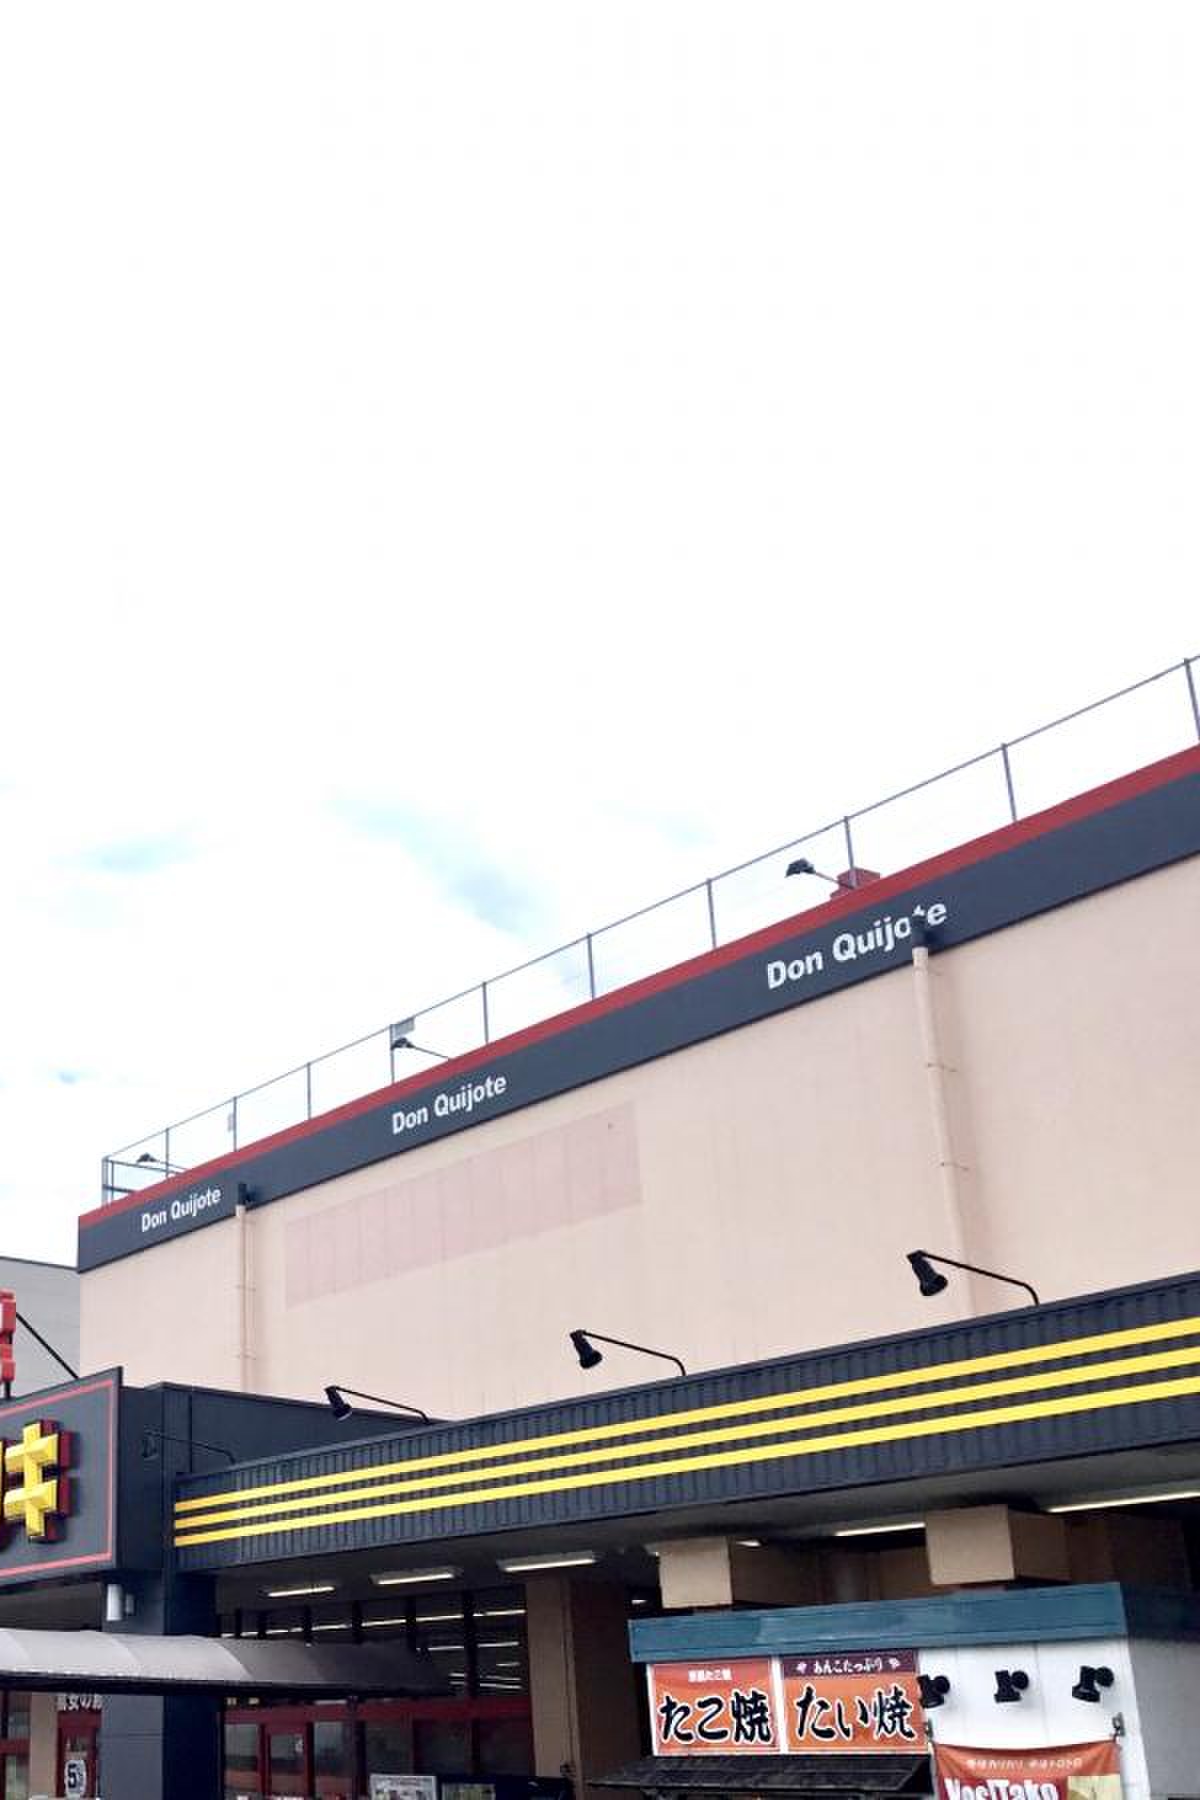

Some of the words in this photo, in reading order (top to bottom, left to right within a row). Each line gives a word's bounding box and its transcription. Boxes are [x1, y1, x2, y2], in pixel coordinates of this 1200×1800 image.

[767, 951, 823, 989] Don
[392, 1106, 428, 1134] Don
[434, 1076, 507, 1117] Quijote
[141, 1210, 167, 1233] Don
[171, 1186, 221, 1219] Quijote
[658, 1688, 772, 1744] たこ焼
[795, 1683, 917, 1740] たい焼
